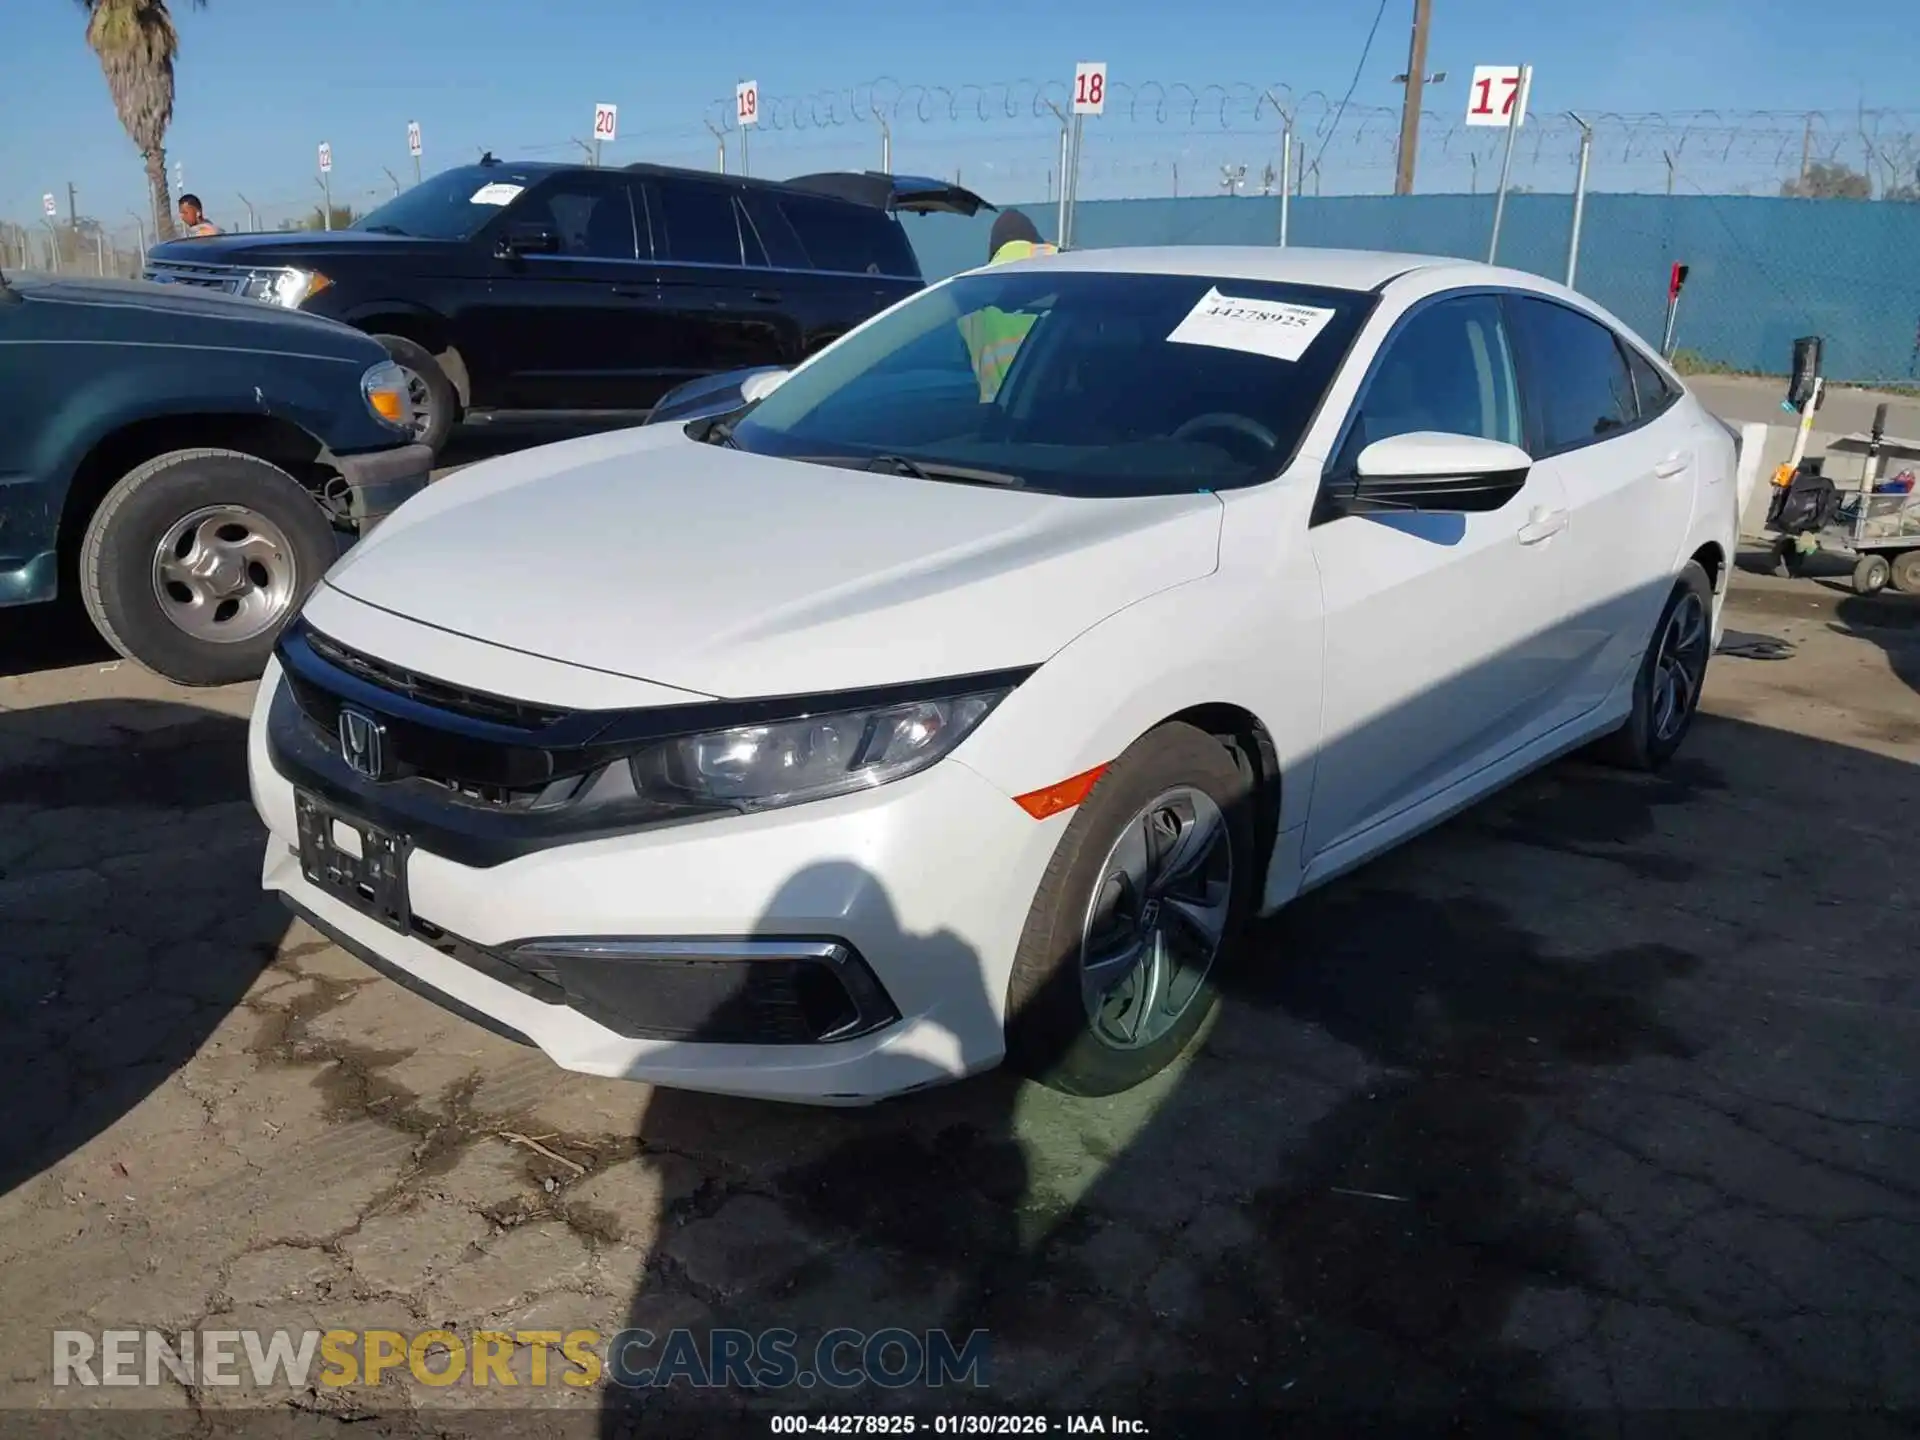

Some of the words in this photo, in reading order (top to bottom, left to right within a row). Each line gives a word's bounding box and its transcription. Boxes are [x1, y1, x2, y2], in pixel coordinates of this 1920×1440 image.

[1075, 73, 1103, 104] 18
[1471, 77, 1525, 114] 17
[739, 89, 756, 116] 19
[596, 110, 614, 133] 20
[410, 129, 420, 149] 21
[1206, 307, 1309, 328] 44278925
